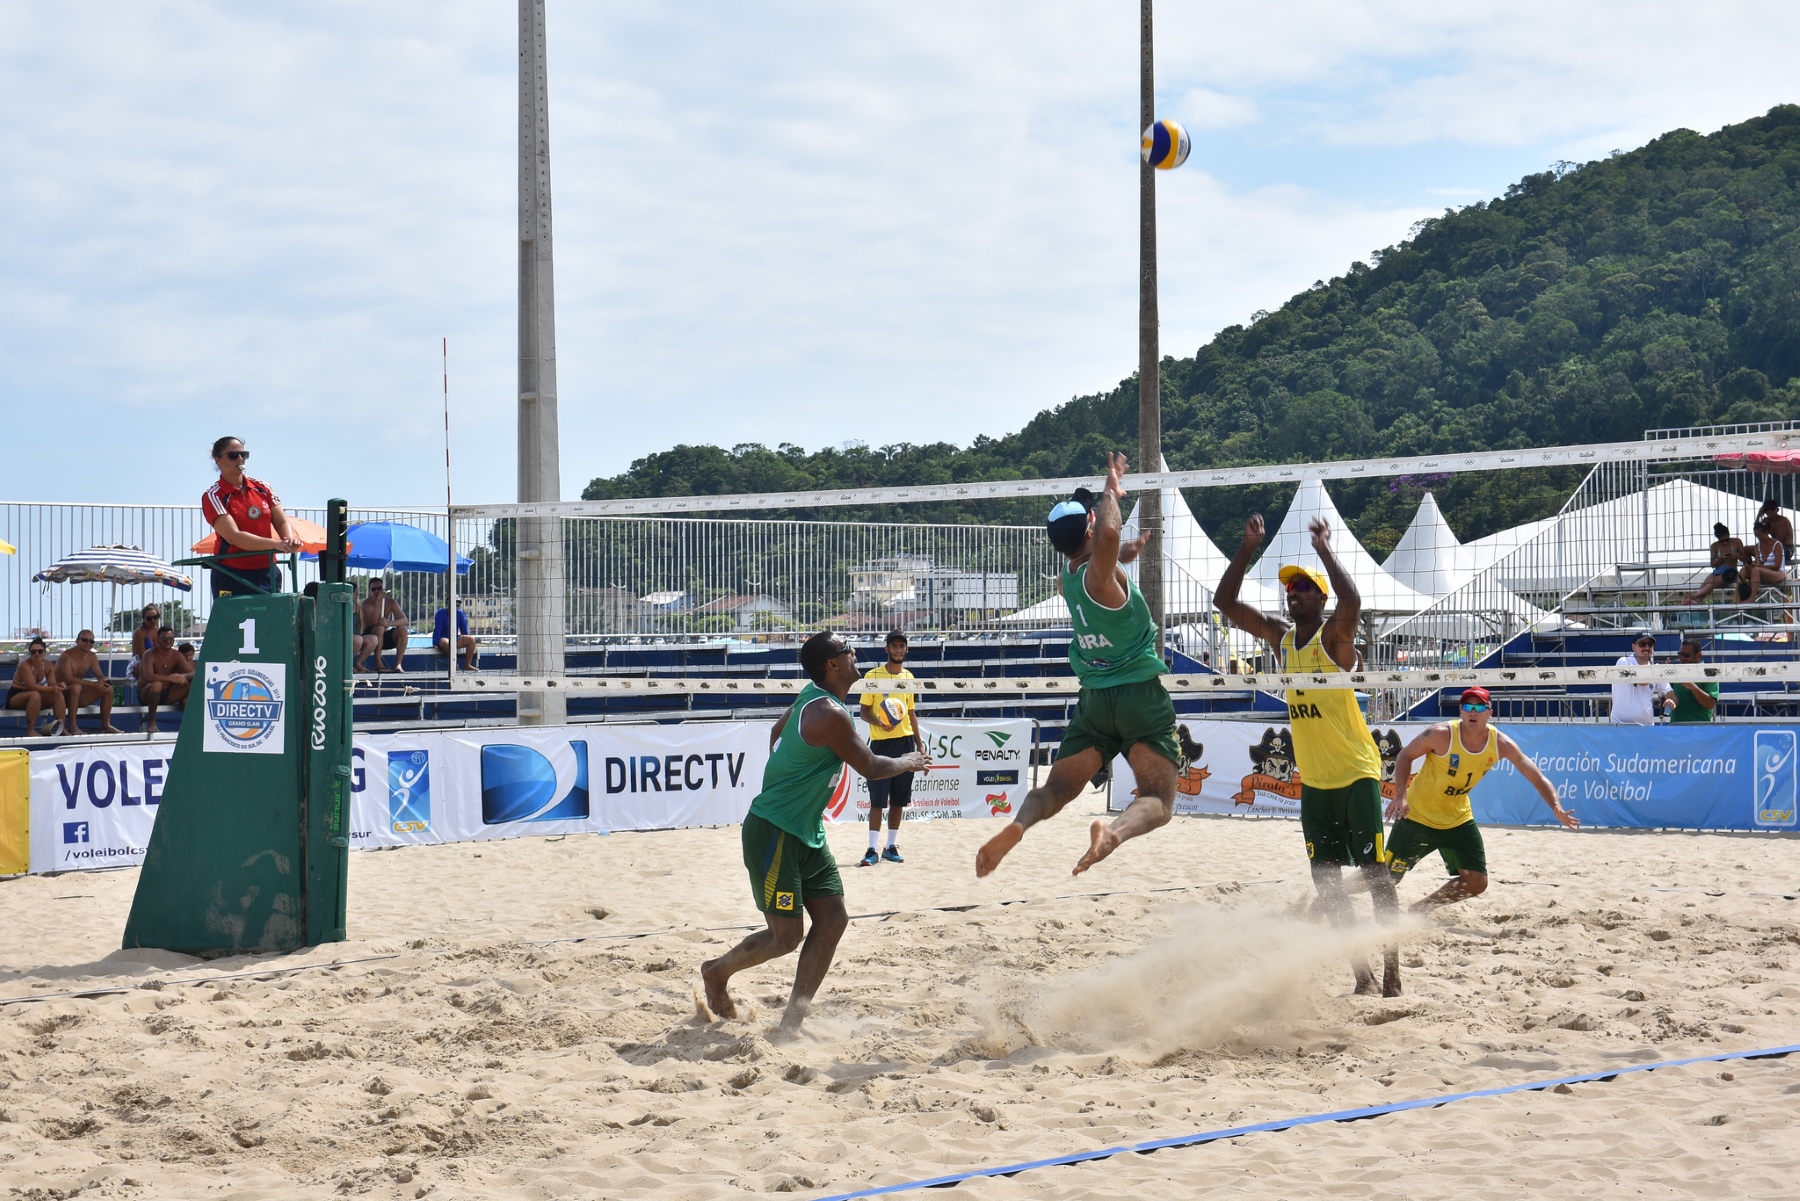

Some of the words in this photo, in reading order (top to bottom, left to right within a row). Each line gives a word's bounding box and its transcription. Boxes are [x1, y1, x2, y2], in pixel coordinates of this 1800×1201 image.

[1076, 604, 1088, 627] 1
[239, 618, 259, 654] 1
[1077, 633, 1114, 650] BRA
[217, 704, 273, 718] DIRECTV
[310, 655, 327, 751] Rio2016
[1289, 703, 1322, 719] BRA
[264, 724, 276, 740] BRASIL
[975, 749, 1020, 761] PENALTY
[1605, 753, 1737, 774] Sudamericana
[605, 752, 745, 794] DIRECTV
[1464, 772, 1473, 788] 1
[56, 758, 172, 809] VOLE
[1558, 779, 1578, 800] de
[1584, 779, 1653, 801] Voleibol
[1760, 810, 1793, 821] CSV
[393, 820, 428, 833] CSV
[65, 846, 148, 861] /voleibolcs
